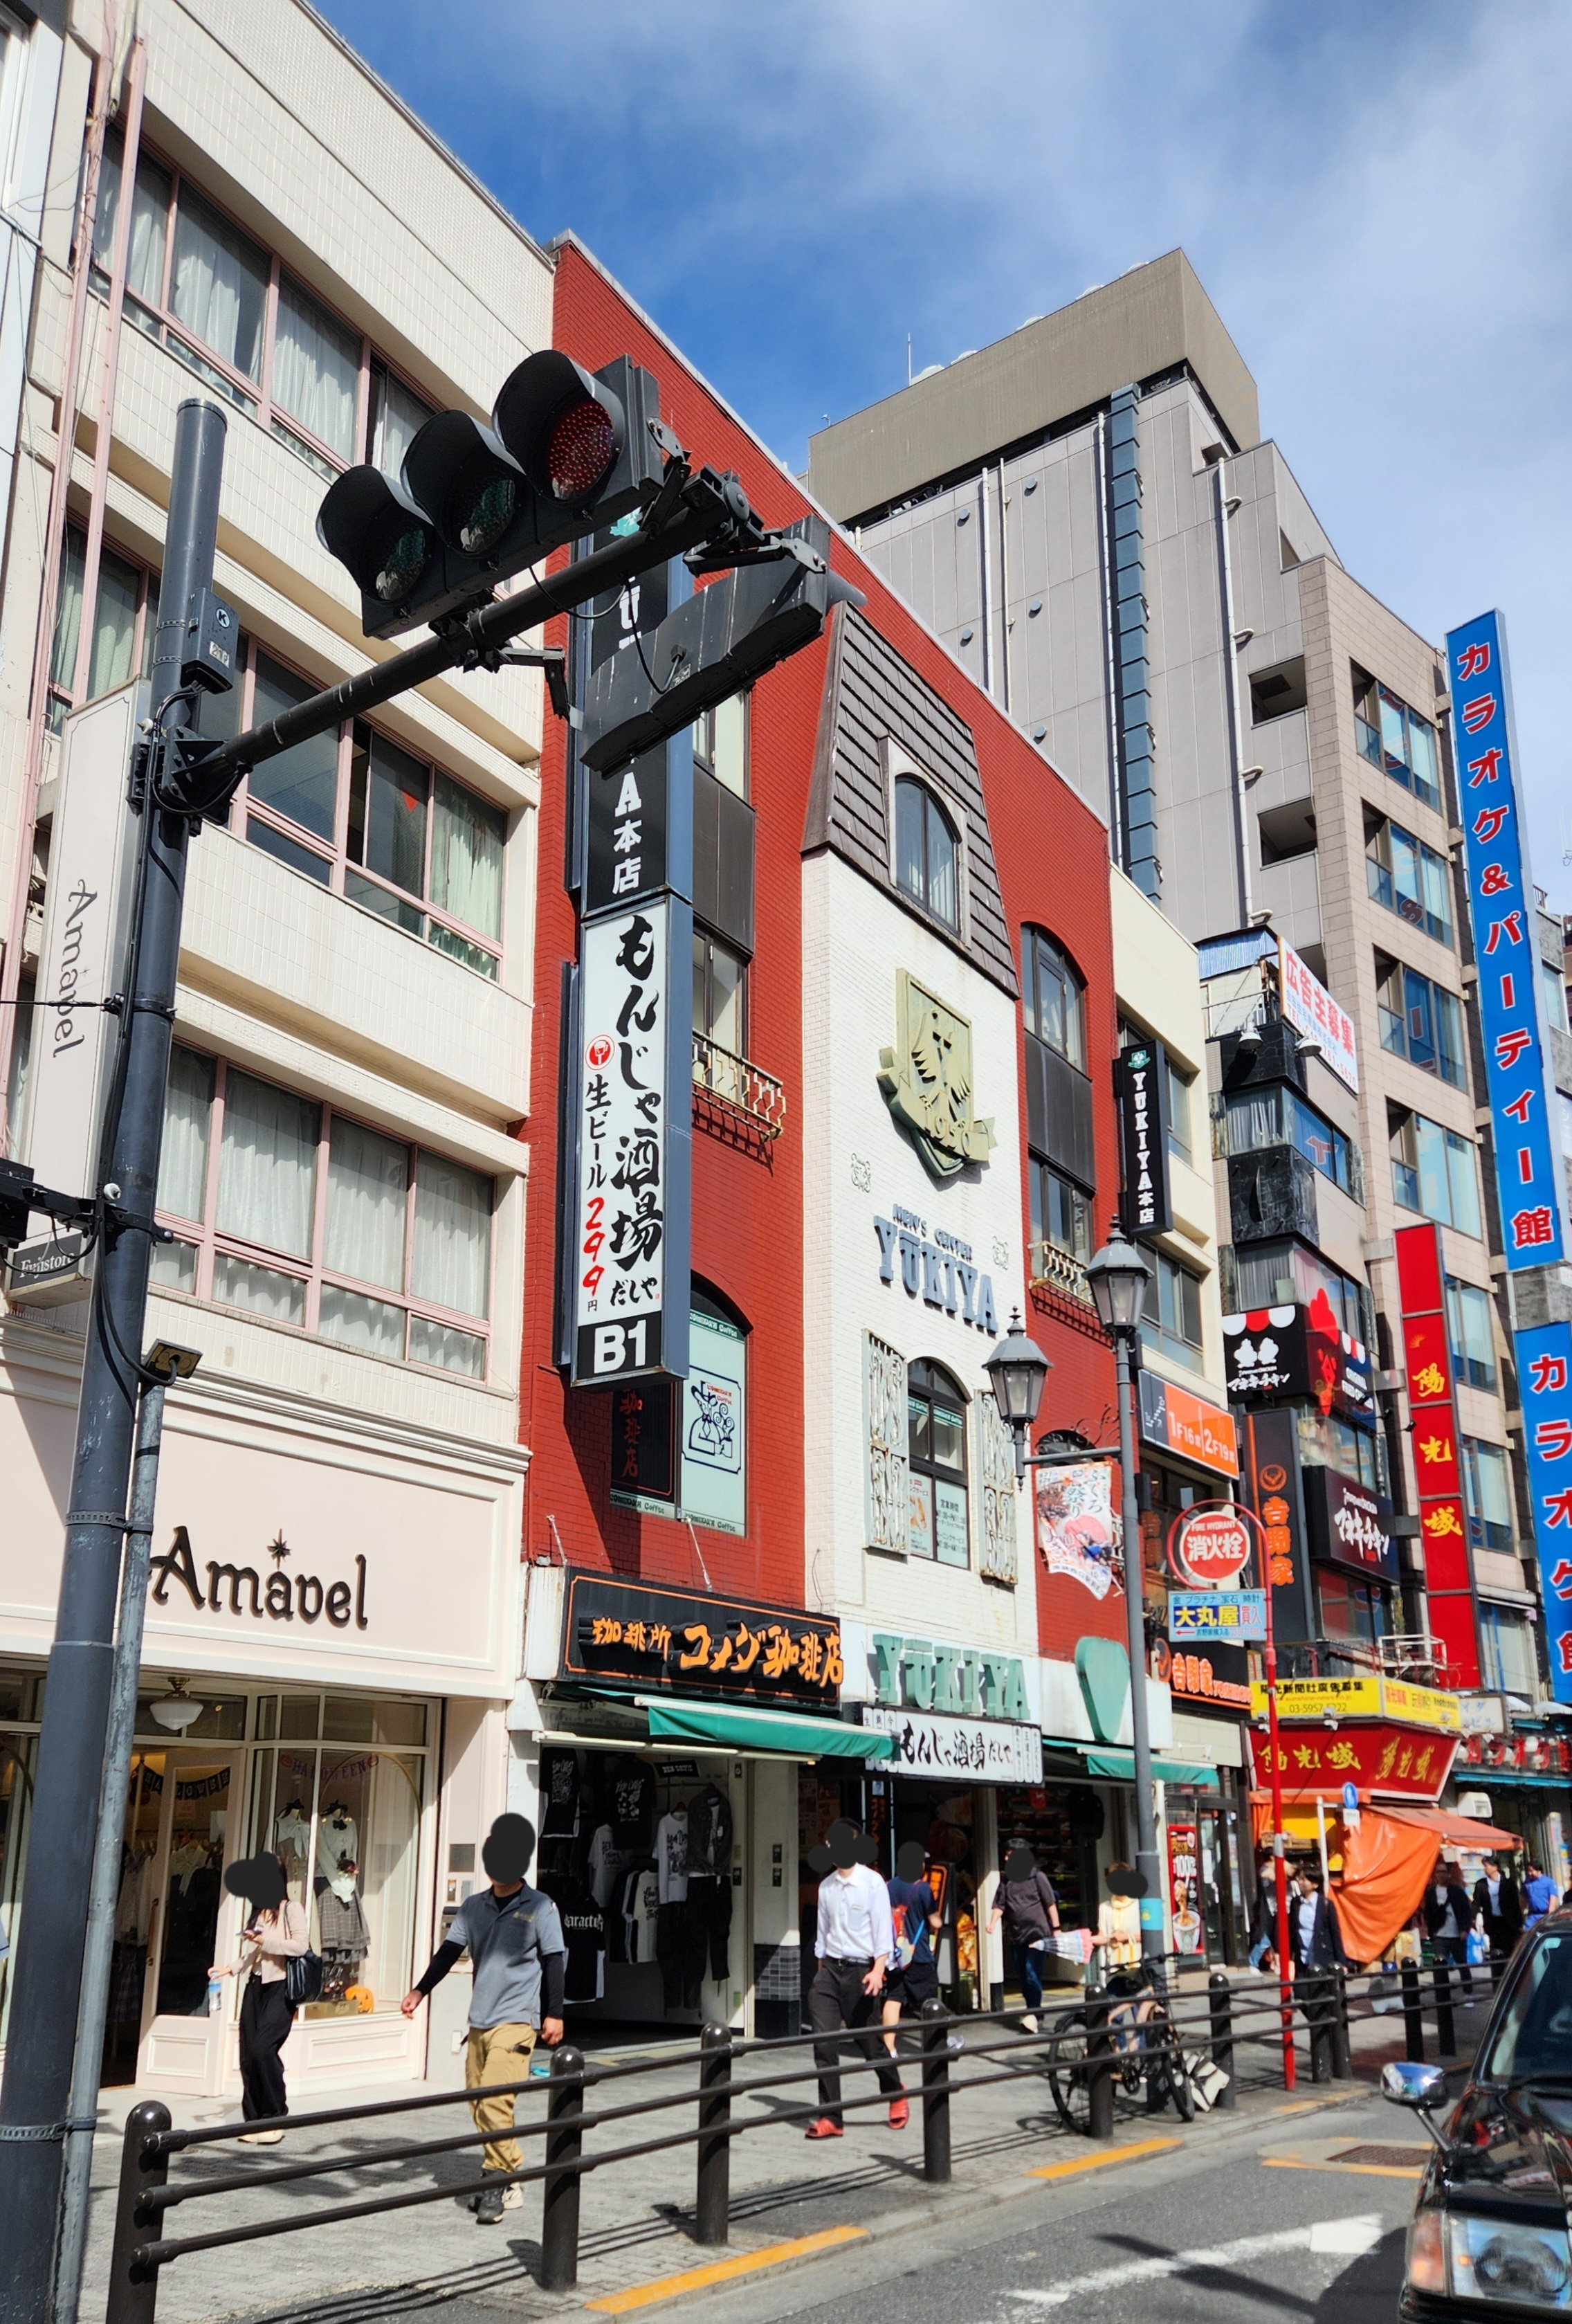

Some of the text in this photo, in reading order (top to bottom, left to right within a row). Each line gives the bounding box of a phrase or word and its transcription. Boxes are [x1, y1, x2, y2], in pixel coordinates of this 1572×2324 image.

[53, 878, 99, 1059] Amavel
[1456, 640, 1555, 1250] カラオケ&パーティー館
[1286, 949, 1355, 1059] 広告主募集
[610, 915, 663, 1271] もんじゃ酒場
[893, 1204, 973, 1261] MEN'S CENTER
[593, 1318, 647, 1374] B1
[1411, 1362, 1463, 1537] 陽光城
[643, 1501, 665, 1515] Coffee
[717, 1520, 736, 1533] Coffee
[1191, 1520, 1236, 1532] FIRE HYDRANT
[1187, 1532, 1244, 1562] 消火栓
[1262, 1496, 1295, 1586] 吉野家
[149, 1525, 368, 1631] Amavel
[1175, 1606, 1239, 1627] 大丸屋
[680, 1621, 843, 1689] コメダ珈琲店
[1172, 1652, 1214, 1696] 吉野家
[901, 1718, 985, 1772] もんじゃ酒場
[1259, 1741, 1362, 1773] 陽光城
